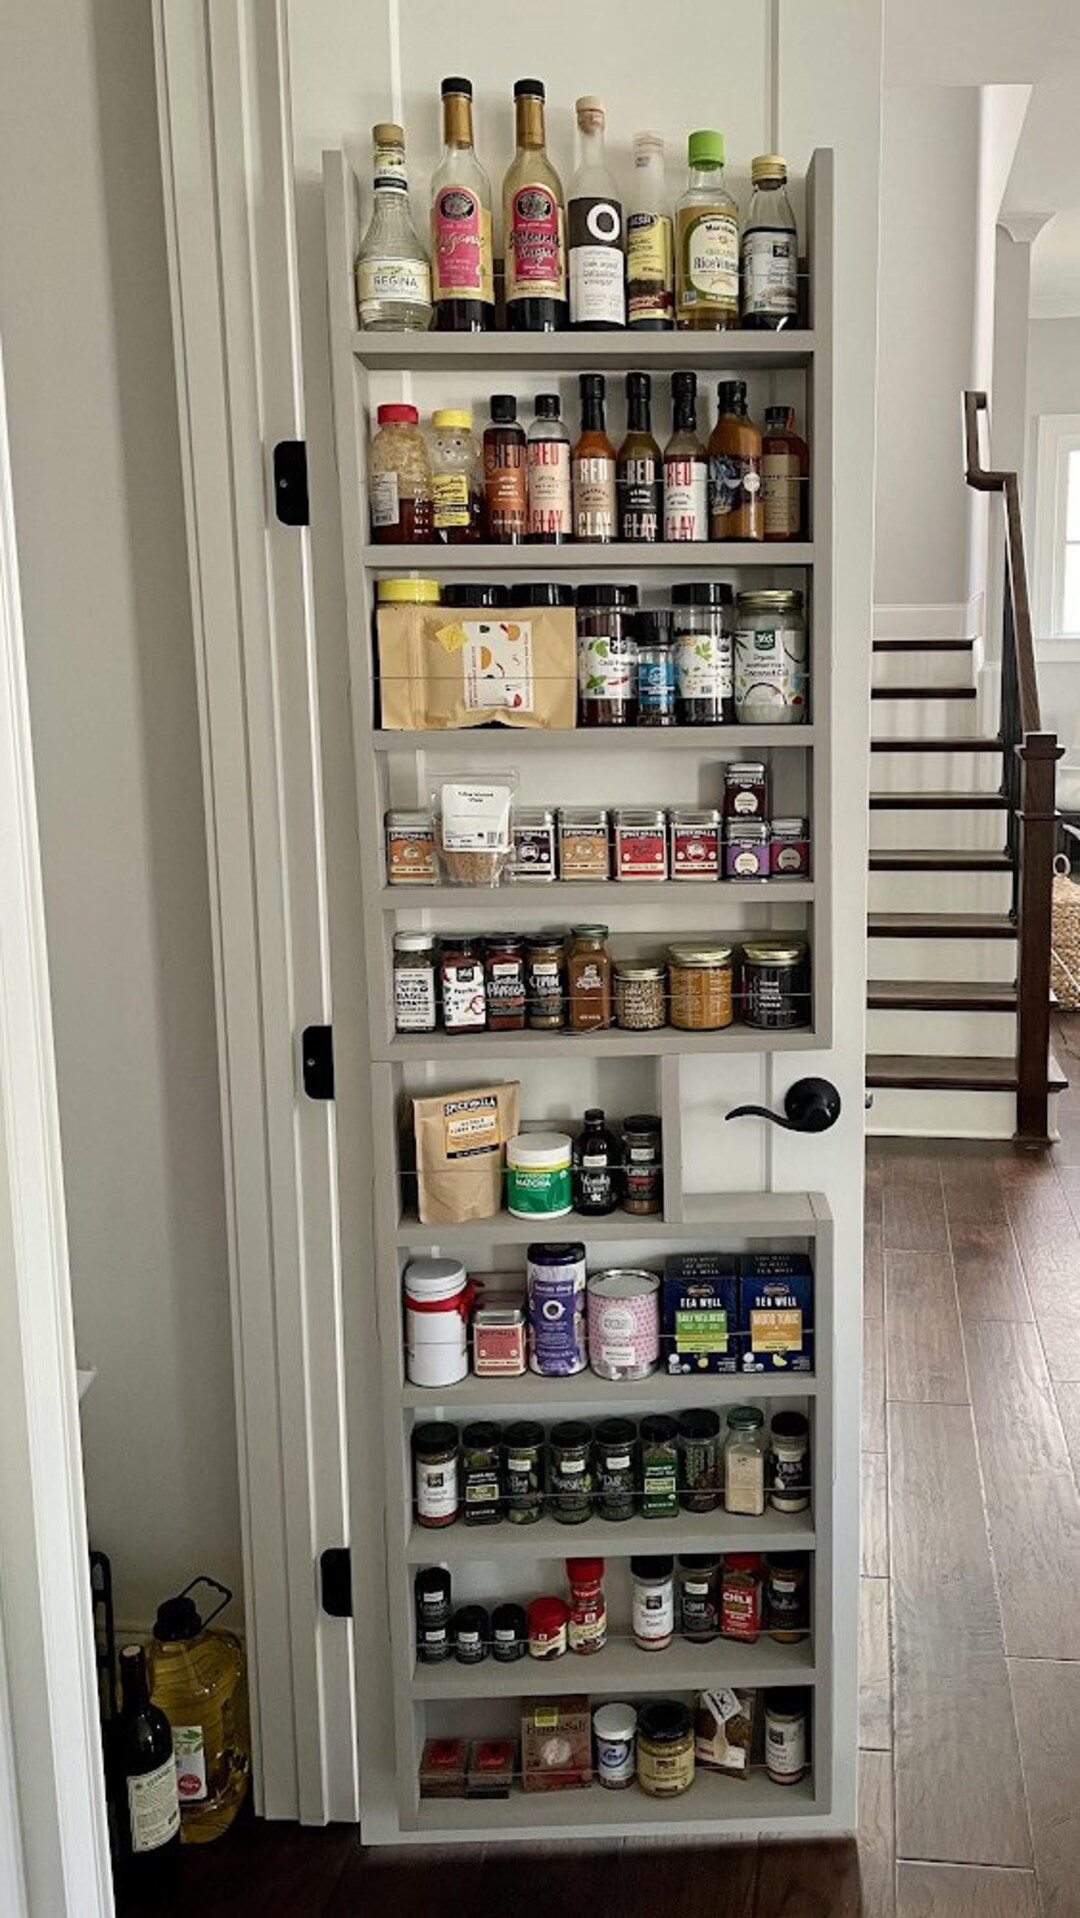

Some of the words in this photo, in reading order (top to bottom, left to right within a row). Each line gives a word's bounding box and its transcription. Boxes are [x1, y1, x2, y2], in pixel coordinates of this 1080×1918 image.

[587, 203, 620, 242] O
[373, 275, 418, 289] REGINA
[580, 457, 608, 484] RED
[626, 459, 655, 484] RED
[666, 461, 692, 489] RED
[578, 513, 612, 537] CLAY
[624, 513, 657, 538] CLAY
[665, 515, 696, 541] CLAY
[757, 634, 774, 644] 365
[744, 669, 777, 677] Coconut
[445, 1098, 496, 1115] SPICEWALLA
[516, 1179, 551, 1187] MATCHA
[581, 1174, 611, 1186] Vanilla
[680, 1298, 698, 1308] TEA
[699, 1298, 722, 1308] WELL
[755, 1296, 773, 1307] TEA
[774, 1296, 797, 1307] WELL
